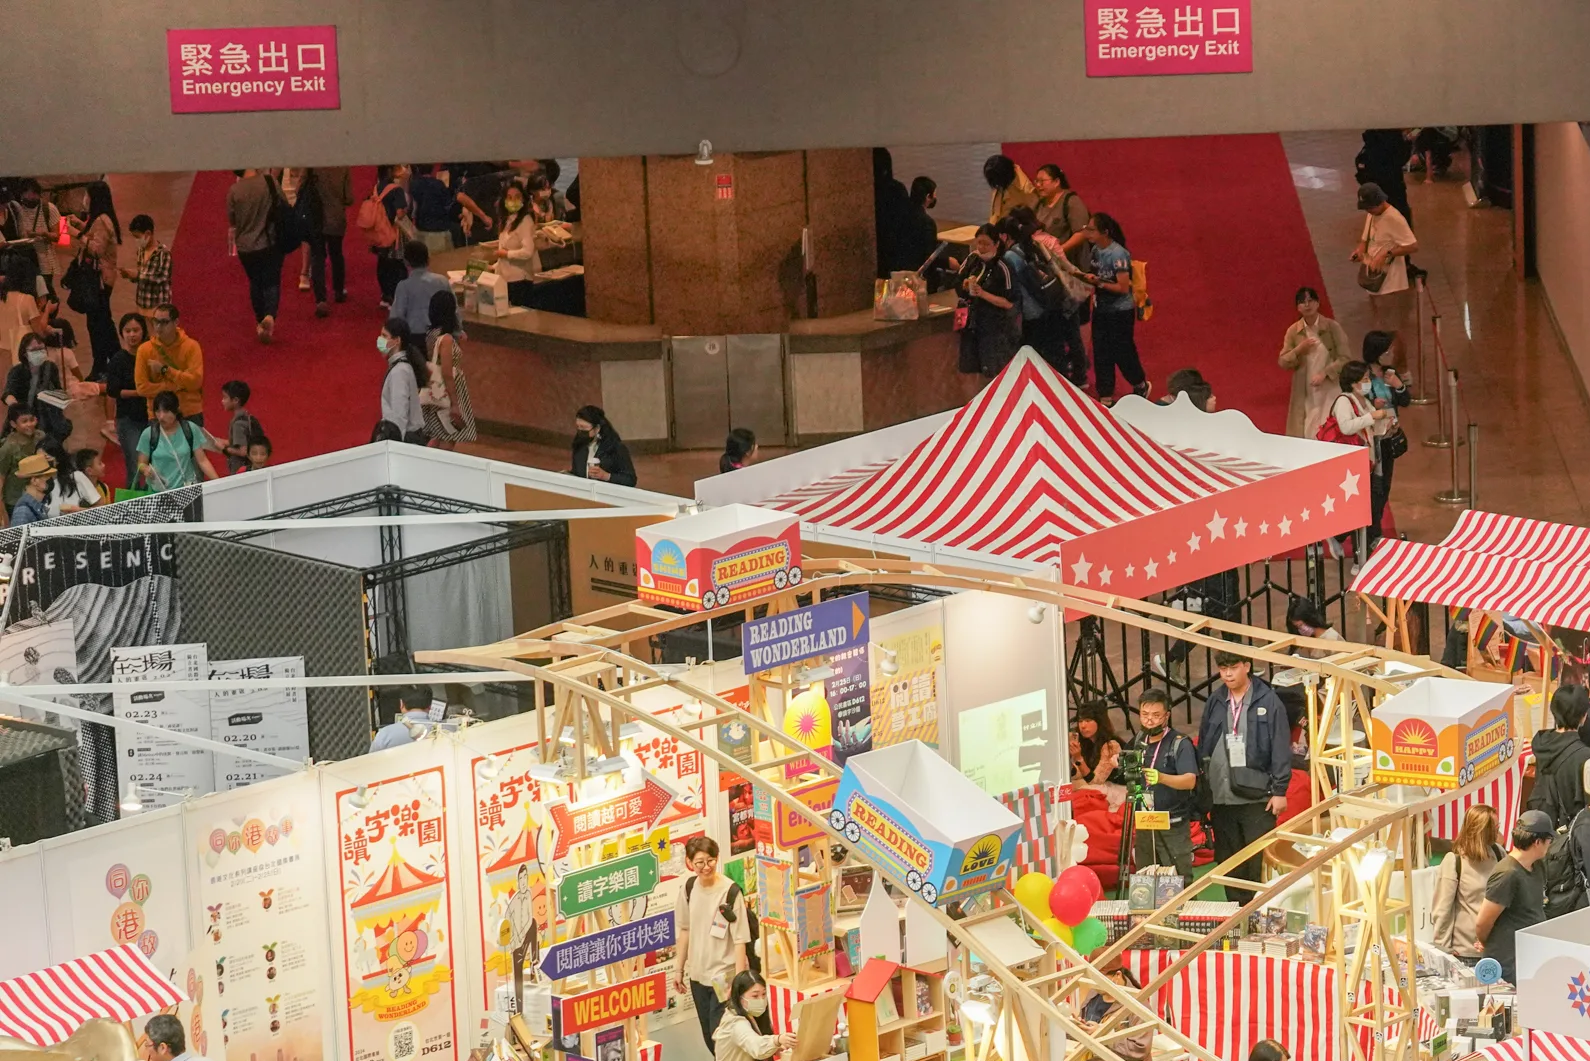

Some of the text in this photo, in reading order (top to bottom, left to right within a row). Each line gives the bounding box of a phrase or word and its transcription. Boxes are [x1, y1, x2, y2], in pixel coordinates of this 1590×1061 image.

[1097, 5, 1240, 41] 緊急出口
[180, 41, 326, 76] 緊急出口
[1098, 40, 1240, 60] Emergency Exit
[182, 76, 326, 97] Emergency Exit
[717, 550, 786, 581] READING
[749, 610, 813, 646] READING
[750, 625, 847, 669] WONDERLAND
[125, 710, 158, 719] 02.23
[224, 734, 257, 743] 02.20
[1395, 744, 1435, 756] HAPPY
[1467, 724, 1506, 757] READING
[129, 773, 163, 783] 02.24
[225, 773, 258, 782] 02.21
[573, 797, 643, 834] 閱讀越可愛
[211, 819, 293, 852] 同你港故事
[343, 800, 442, 866] 讀字樂園
[852, 799, 928, 872] READING
[962, 856, 995, 875] LOVE
[577, 864, 640, 904] 讀字樂園
[556, 917, 670, 974] 閱讀讓你更快樂
[378, 1001, 427, 1020] WONDERLAND
[386, 999, 418, 1013] READING
[573, 980, 656, 1027] WELCOME
[421, 1040, 452, 1056] D612
